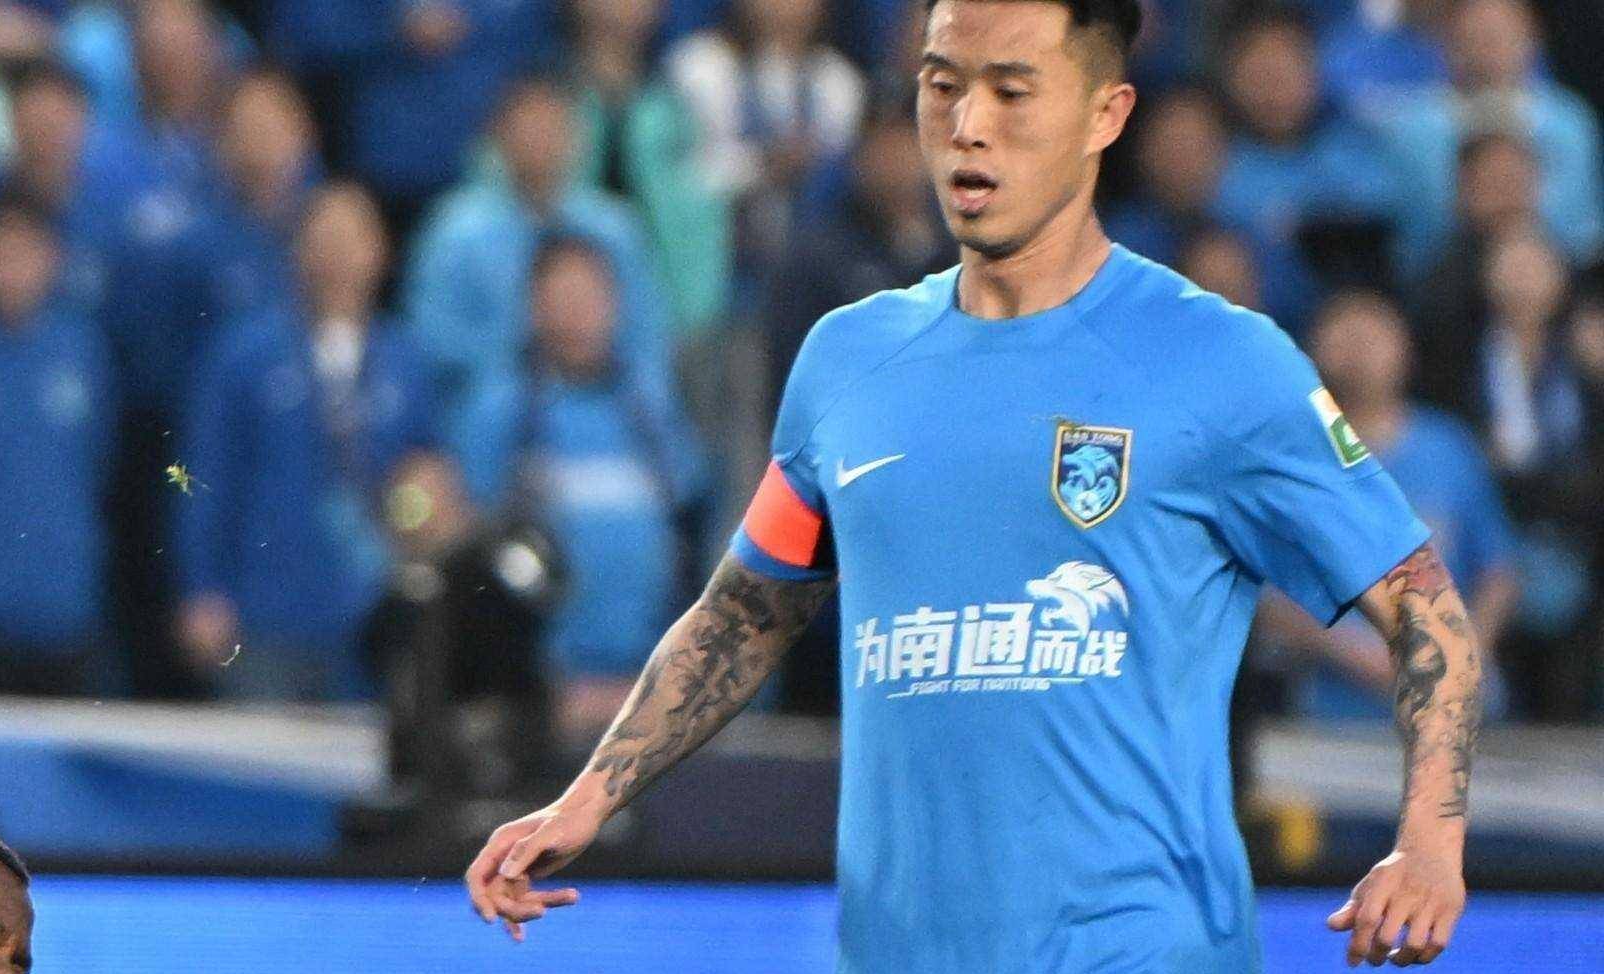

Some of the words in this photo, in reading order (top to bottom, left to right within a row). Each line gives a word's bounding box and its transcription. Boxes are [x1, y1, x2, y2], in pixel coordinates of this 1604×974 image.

[854, 602, 1127, 688] 为南通而战
